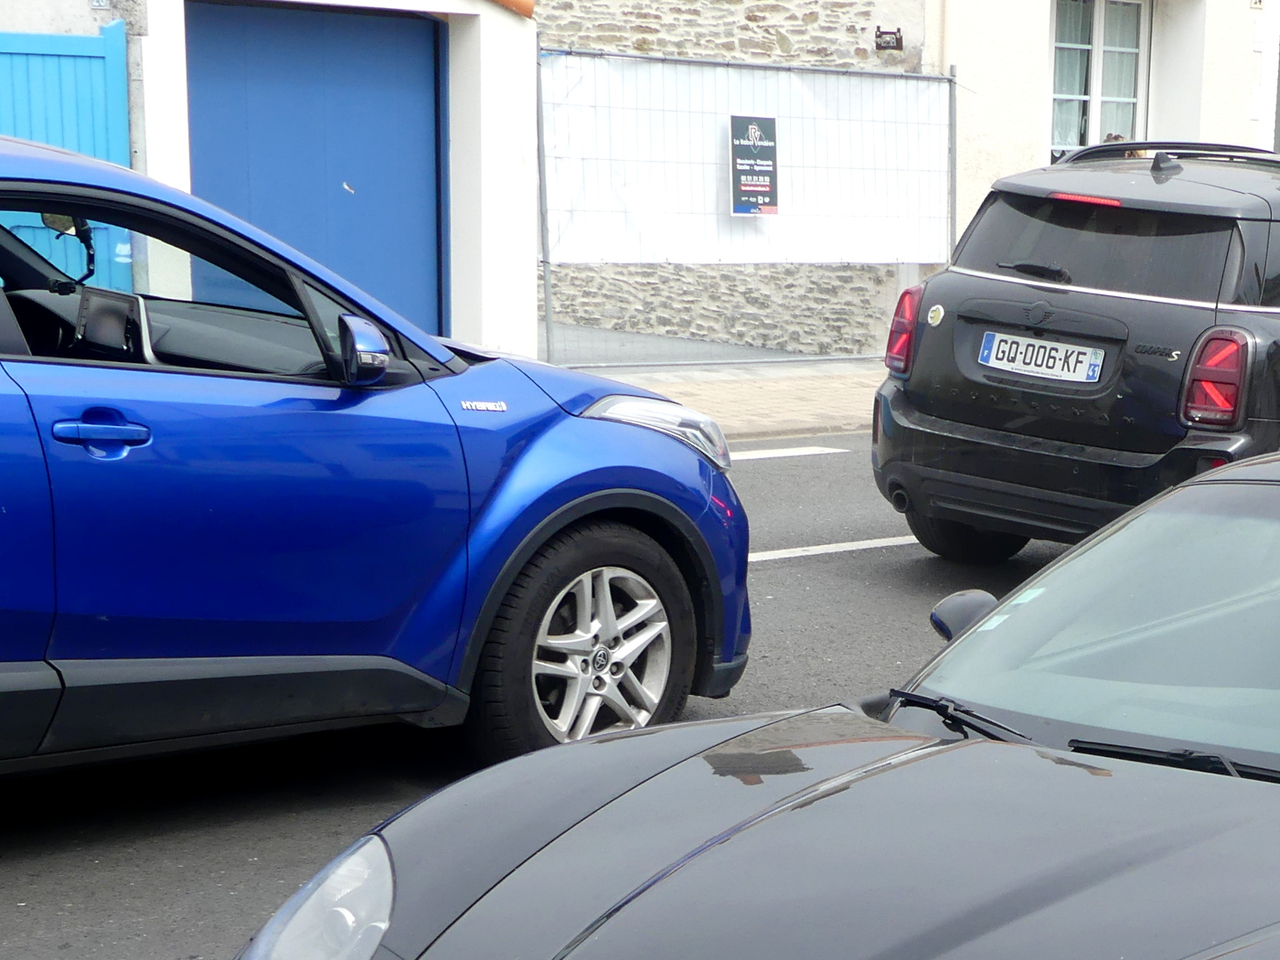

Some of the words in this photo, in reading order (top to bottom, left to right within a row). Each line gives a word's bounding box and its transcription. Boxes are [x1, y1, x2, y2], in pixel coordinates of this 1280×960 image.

[994, 338, 1088, 374] GQ-006-KF
[1088, 365, 1099, 378] 41
[1167, 351, 1181, 362] S
